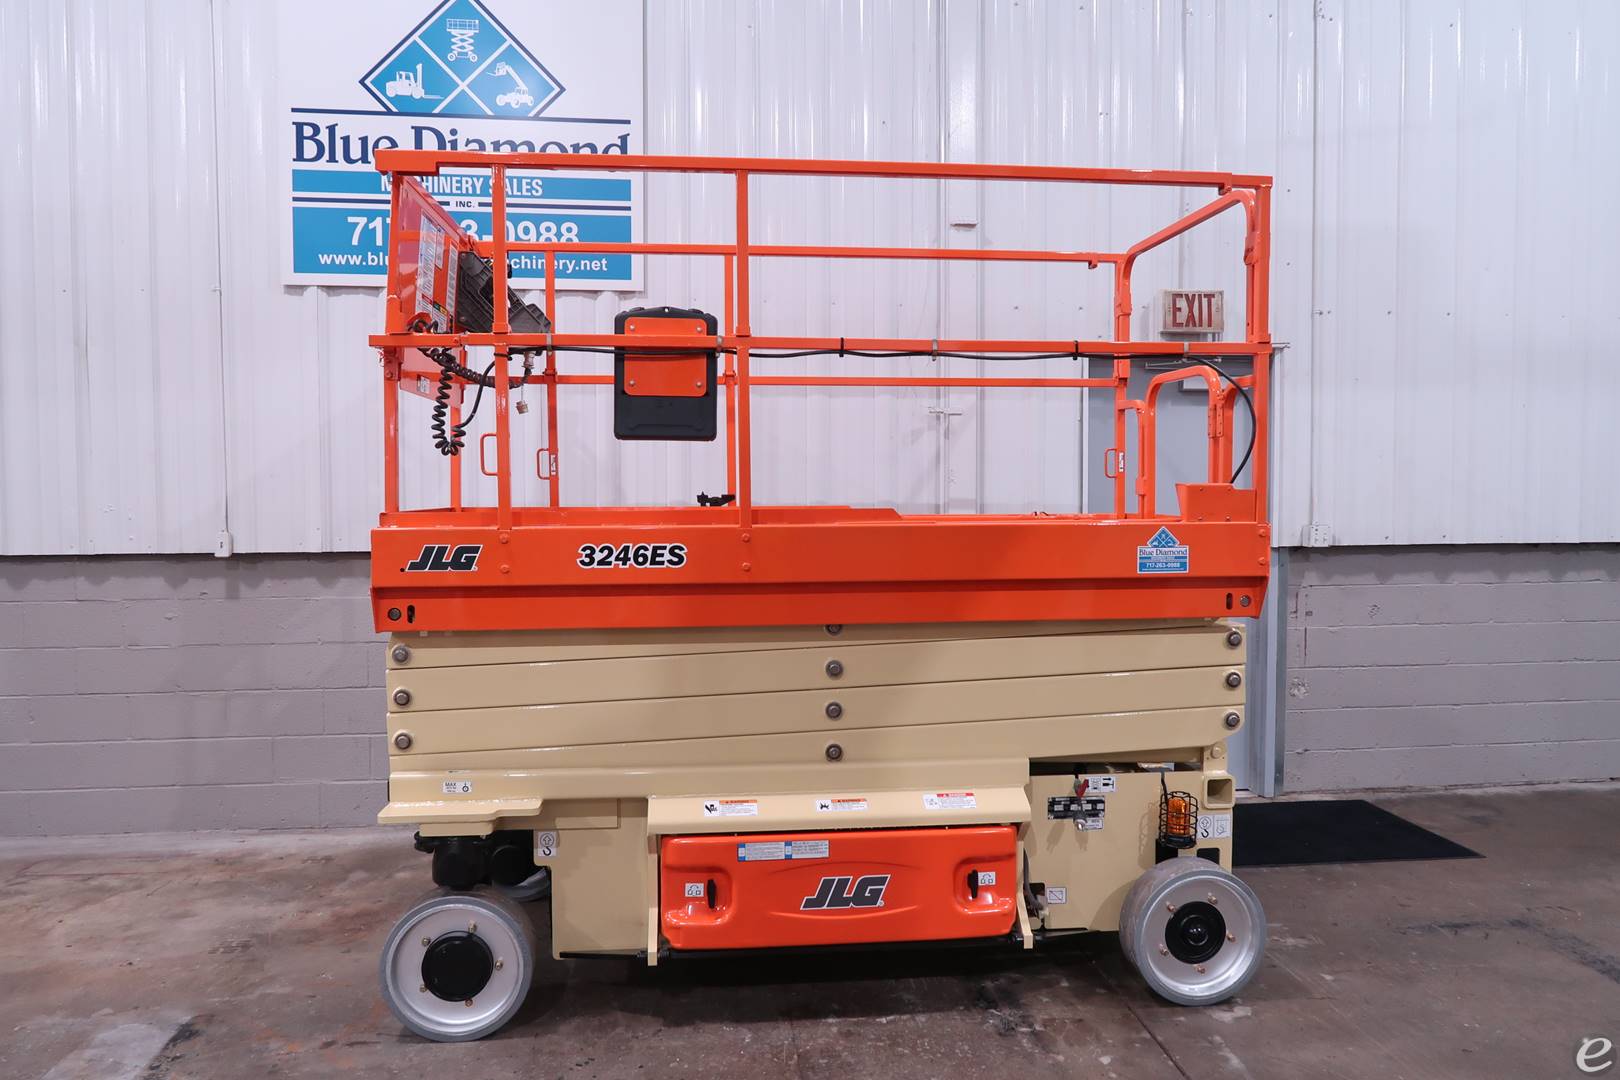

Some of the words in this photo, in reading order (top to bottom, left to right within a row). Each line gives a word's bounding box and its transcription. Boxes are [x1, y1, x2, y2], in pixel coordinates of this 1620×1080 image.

[292, 121, 400, 165] Blue
[381, 174, 483, 195] MHINERY
[489, 177, 543, 196] ALES
[346, 216, 579, 247] 713-988
[1171, 293, 1216, 328] EXIT
[405, 544, 483, 572] JLG
[577, 543, 688, 569] 3246ES
[799, 874, 892, 911] JLG
